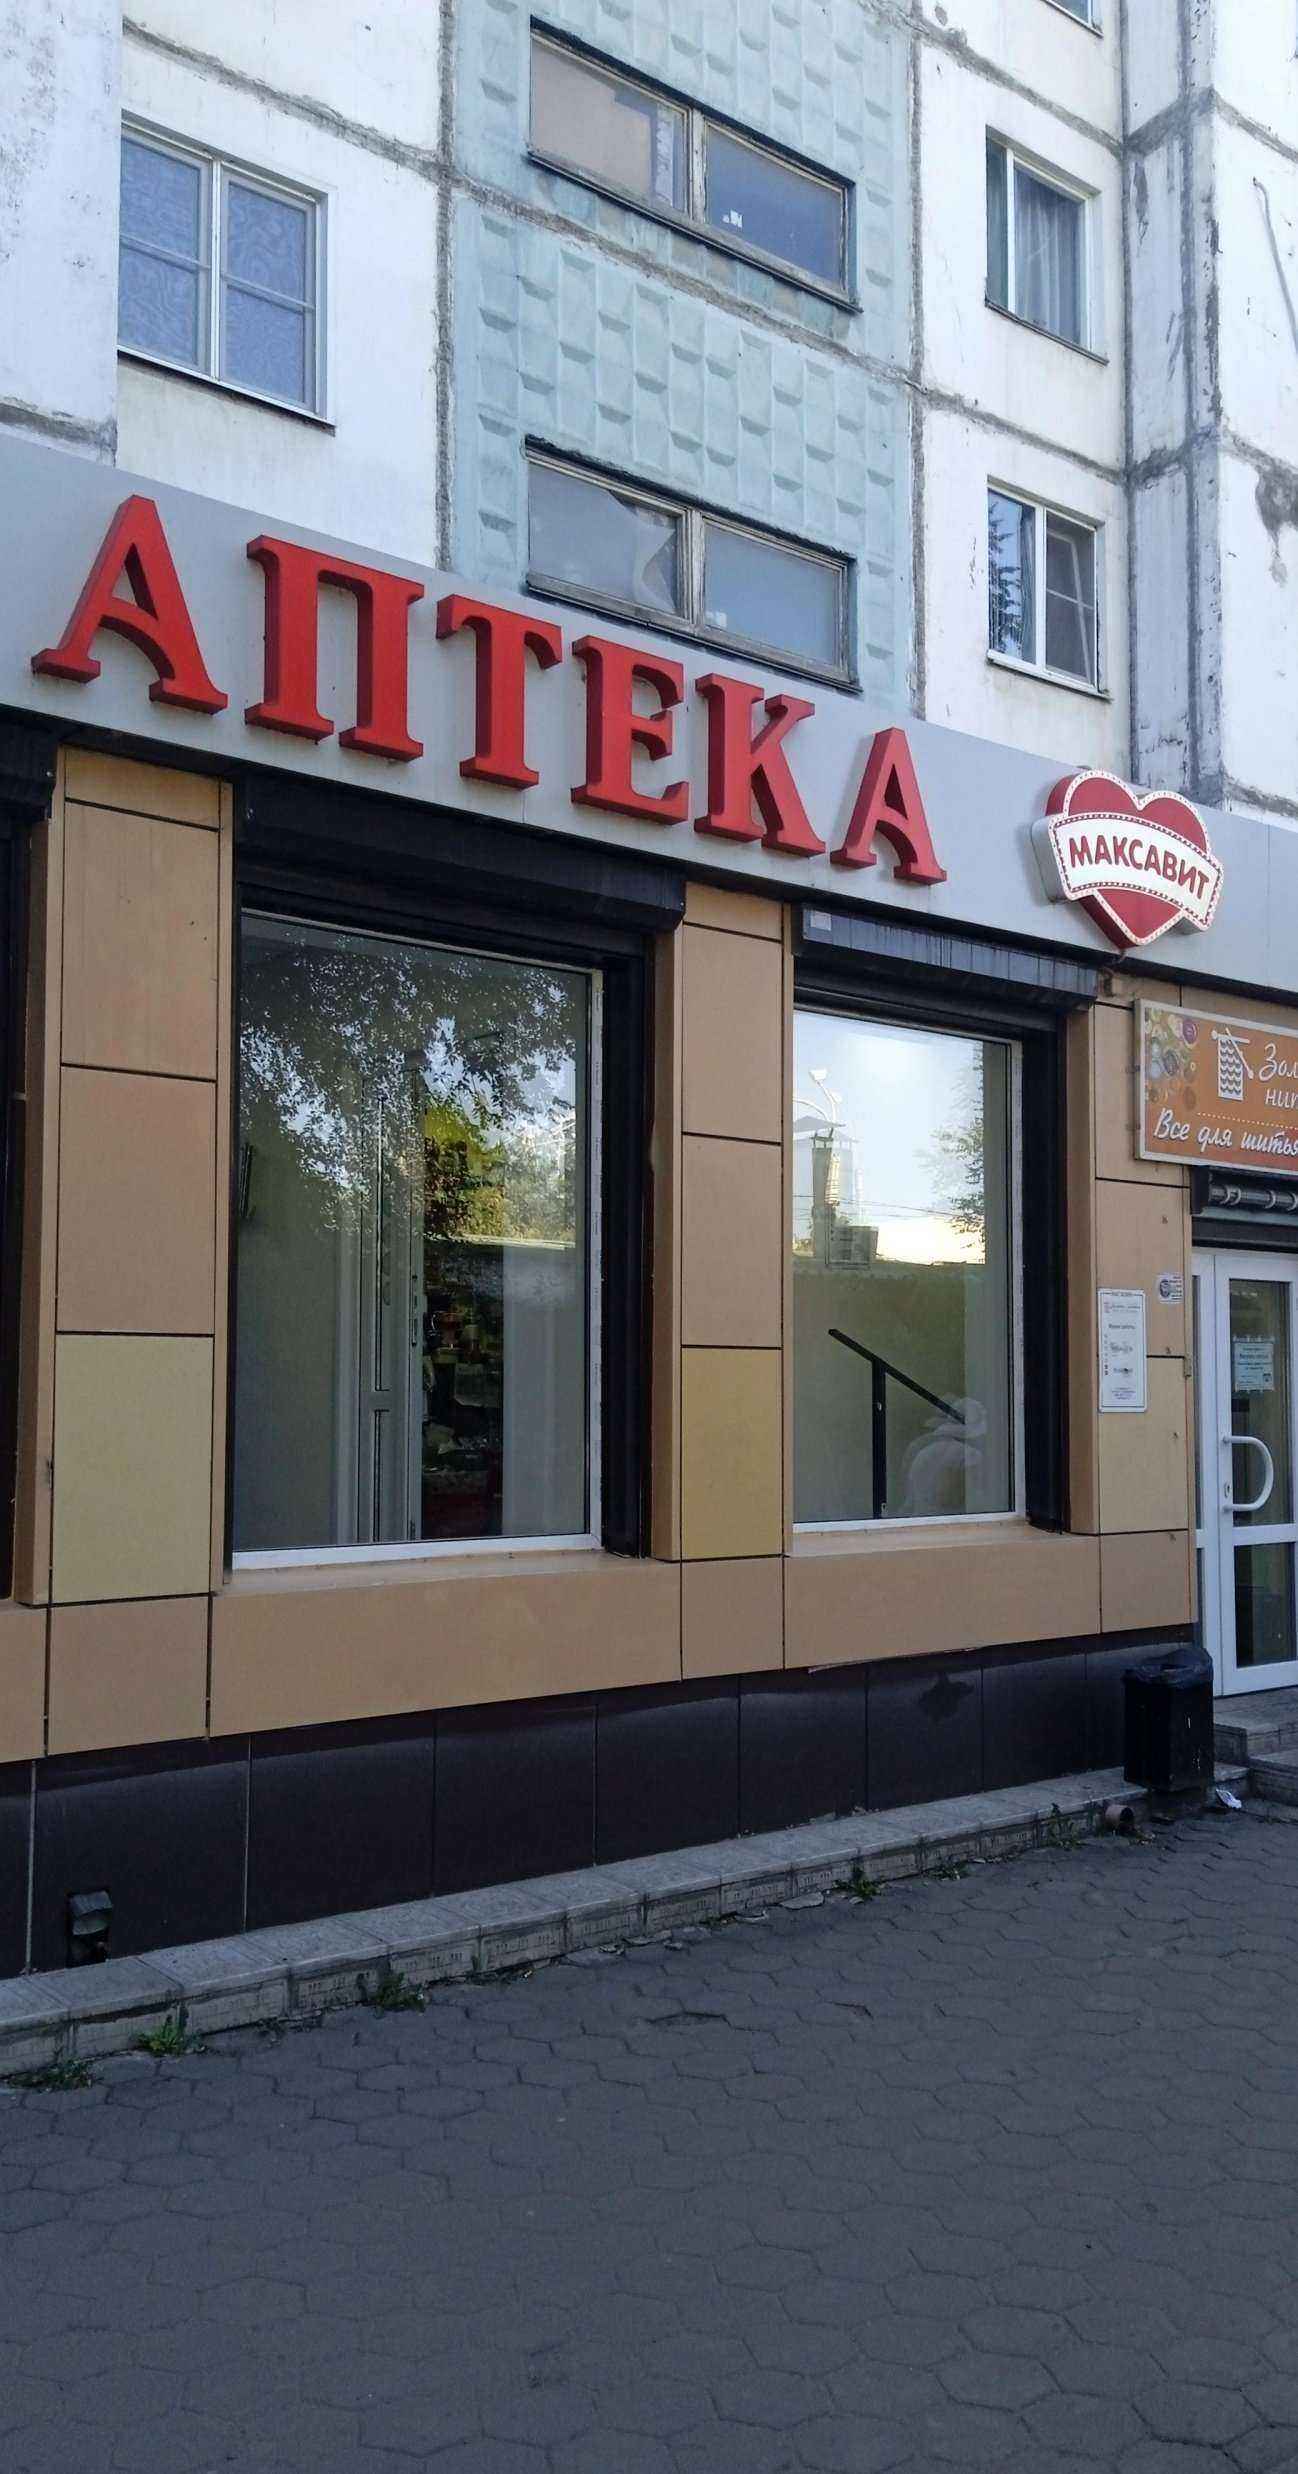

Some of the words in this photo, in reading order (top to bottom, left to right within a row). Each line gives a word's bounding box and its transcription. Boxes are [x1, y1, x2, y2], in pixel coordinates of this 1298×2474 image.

[32, 494, 947, 885] АПТЕКА
[1068, 834, 1210, 900] МАКСАВИТ
[1154, 1107, 1191, 1141] Все
[1198, 1126, 1233, 1153] для
